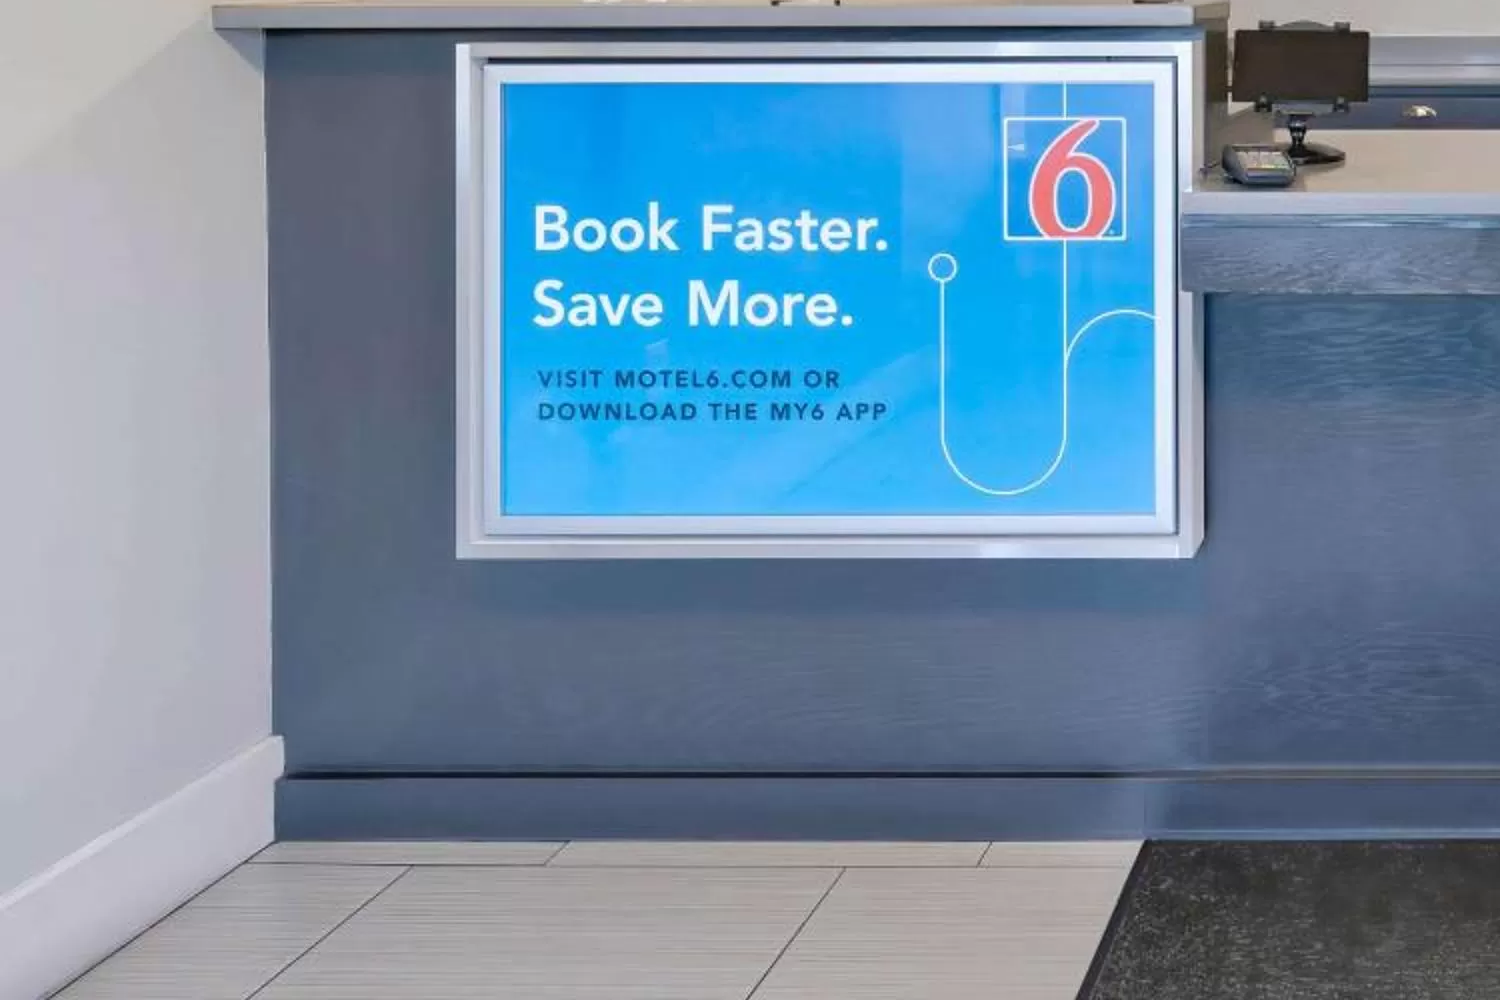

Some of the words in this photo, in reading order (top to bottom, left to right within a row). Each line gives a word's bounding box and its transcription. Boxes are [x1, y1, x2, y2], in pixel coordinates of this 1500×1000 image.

[1029, 118, 1117, 240] 6
[534, 200, 681, 253] Book
[701, 202, 889, 254] Faster.
[532, 277, 665, 329] Save
[687, 278, 854, 329] More.
[537, 369, 603, 389] VISIT
[614, 369, 792, 389] MOTEL6.COM
[803, 369, 840, 389] OR
[537, 401, 698, 422] DOWNLOAD
[707, 402, 758, 422] THE
[770, 402, 825, 421] MY6
[835, 402, 887, 421] APP
